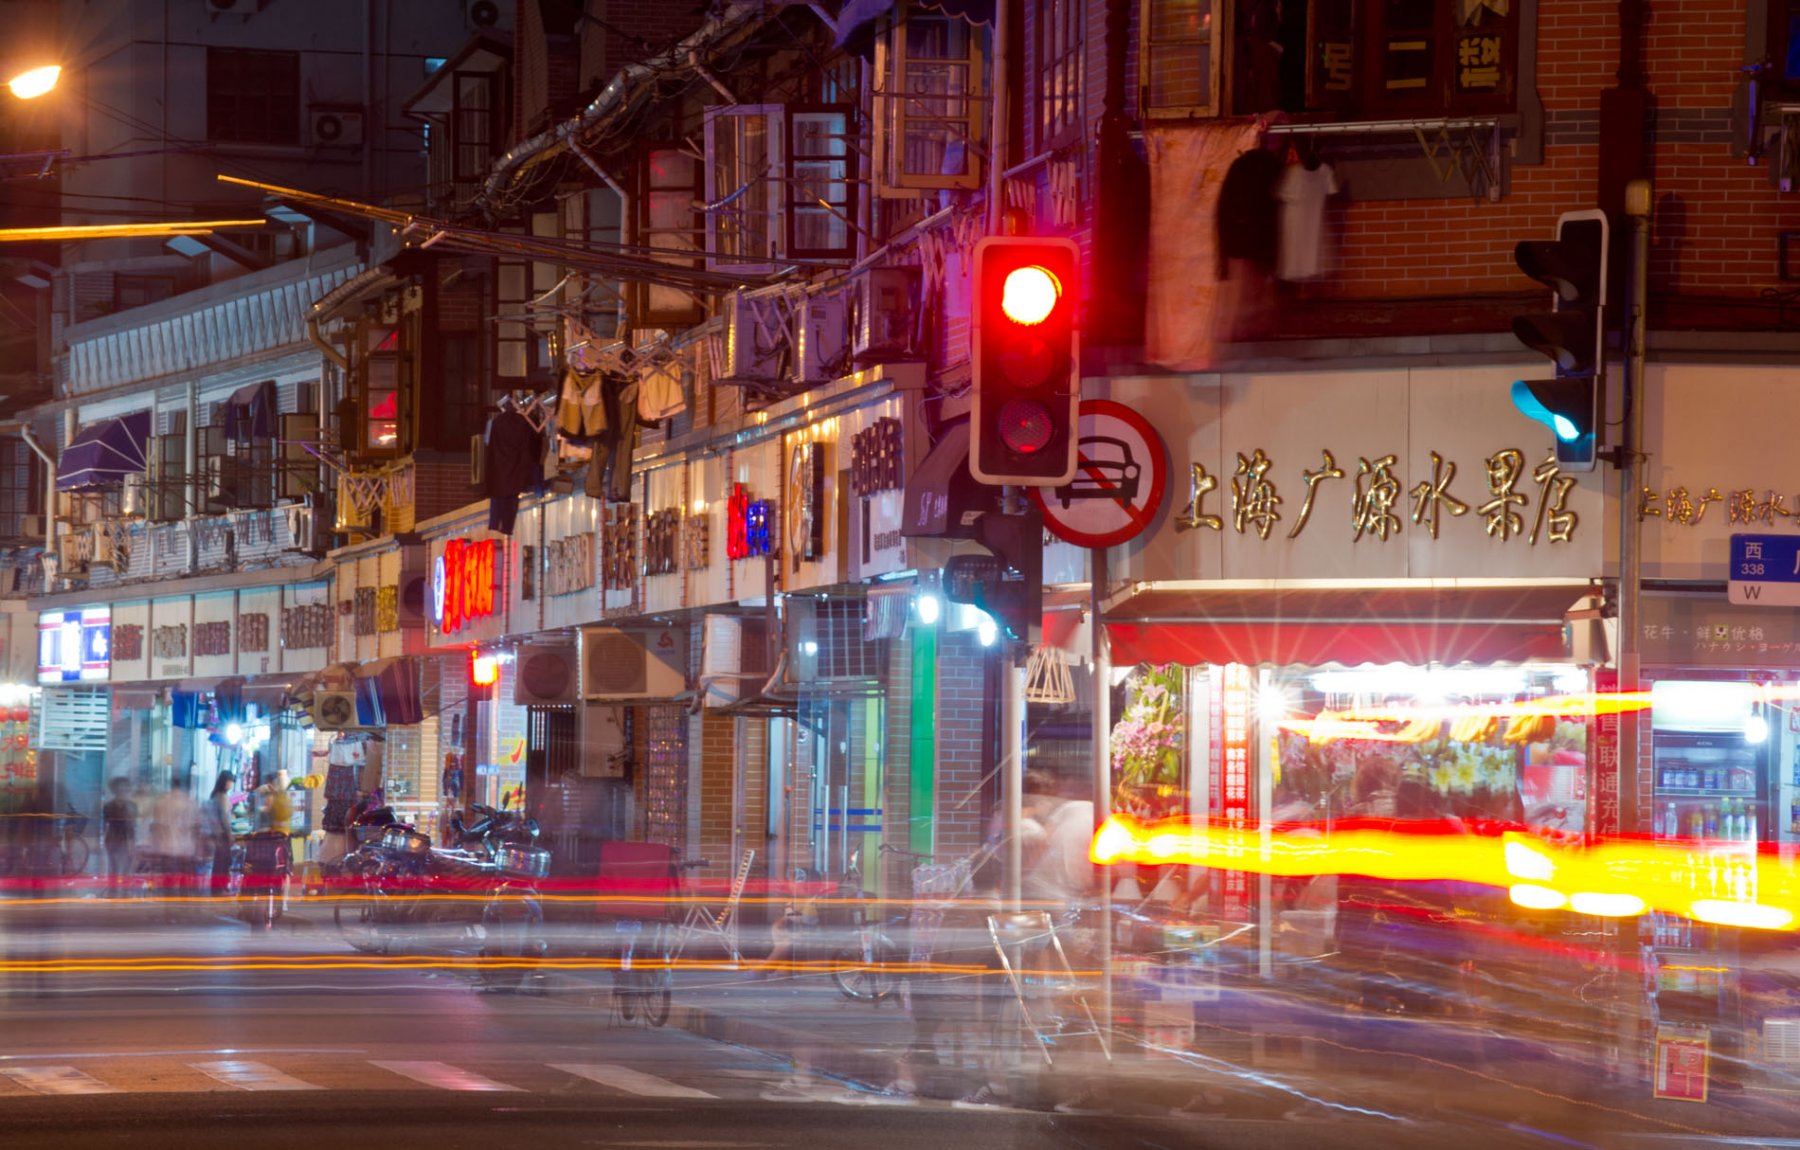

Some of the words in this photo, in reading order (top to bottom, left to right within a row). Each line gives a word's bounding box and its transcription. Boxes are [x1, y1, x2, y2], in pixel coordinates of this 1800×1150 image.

[1174, 448, 1579, 546] 上海广源水果店
[1744, 541, 1764, 561] 西
[1741, 563, 1765, 576] 338
[1743, 585, 1762, 600] W
